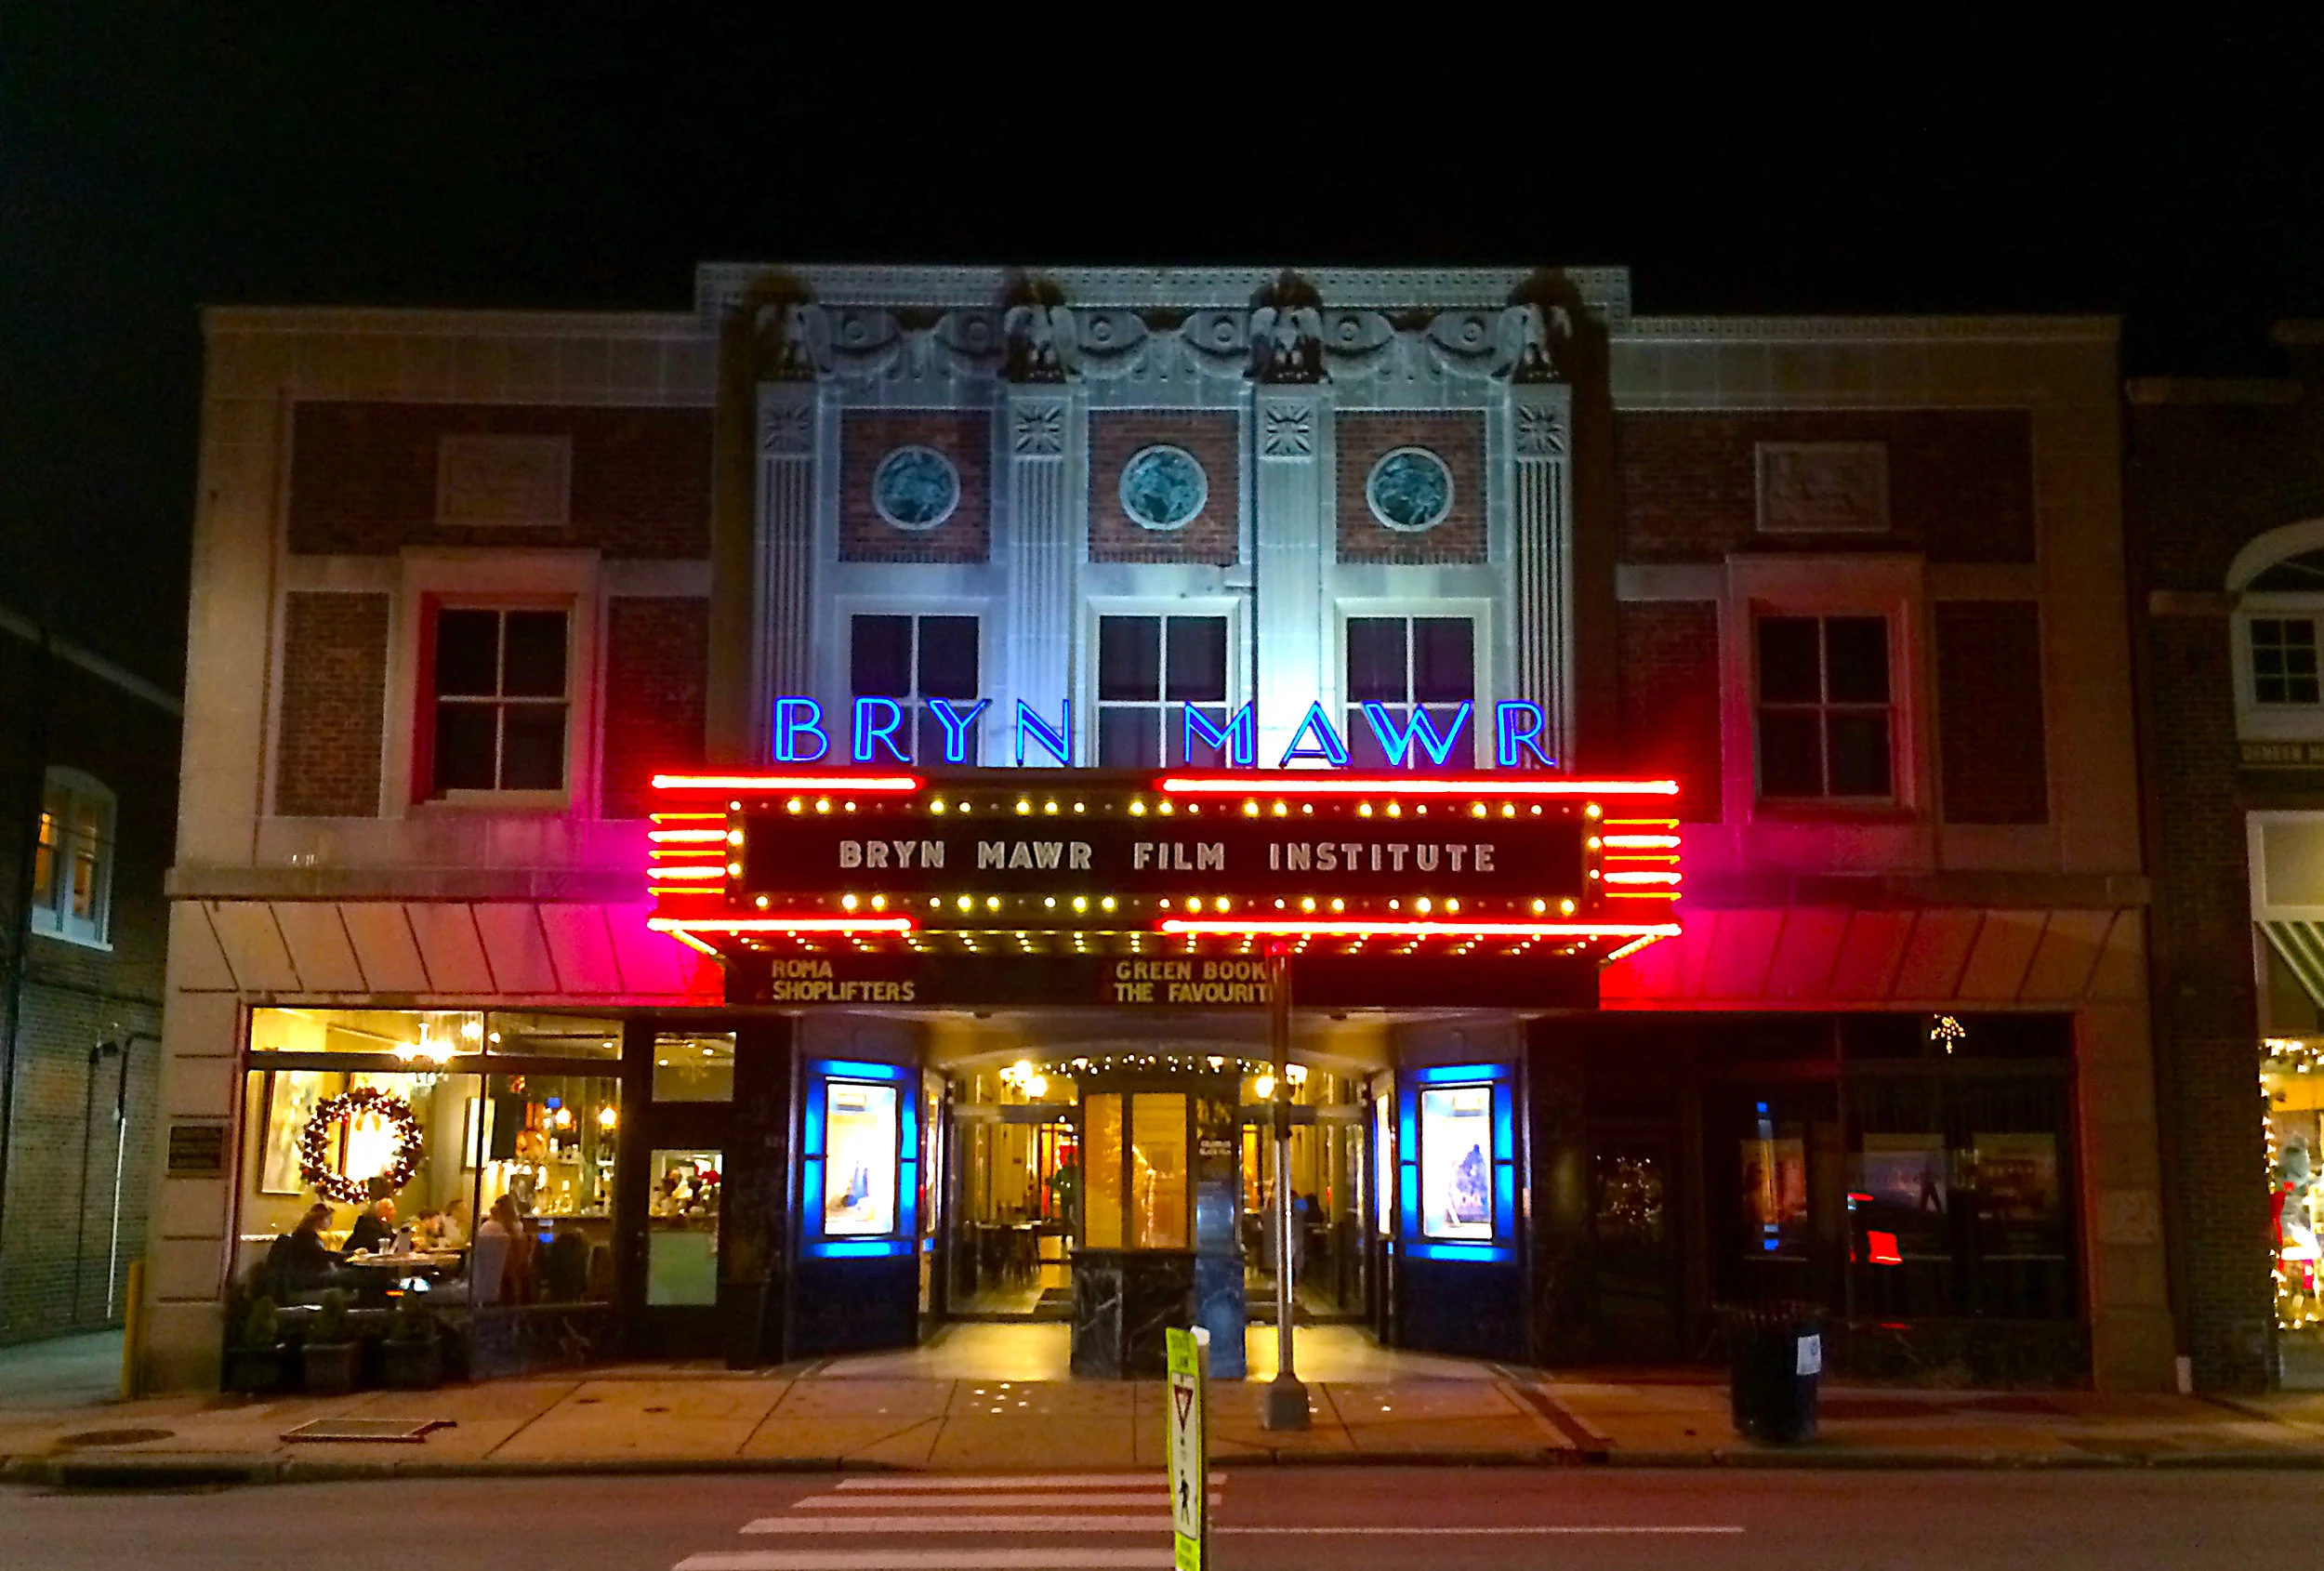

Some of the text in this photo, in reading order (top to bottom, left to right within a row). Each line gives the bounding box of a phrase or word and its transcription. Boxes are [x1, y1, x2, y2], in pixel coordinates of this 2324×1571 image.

[773, 695, 1556, 768] BRYN MAWR
[839, 840, 1496, 872] BRYN MAWR FILM INSTITUTE
[772, 958, 833, 979] ROMA
[1116, 959, 1267, 982] GREEN BOOK
[772, 981, 916, 1002] SHOPLIFTERS
[1114, 982, 1274, 1003] THE FAVOURIT
